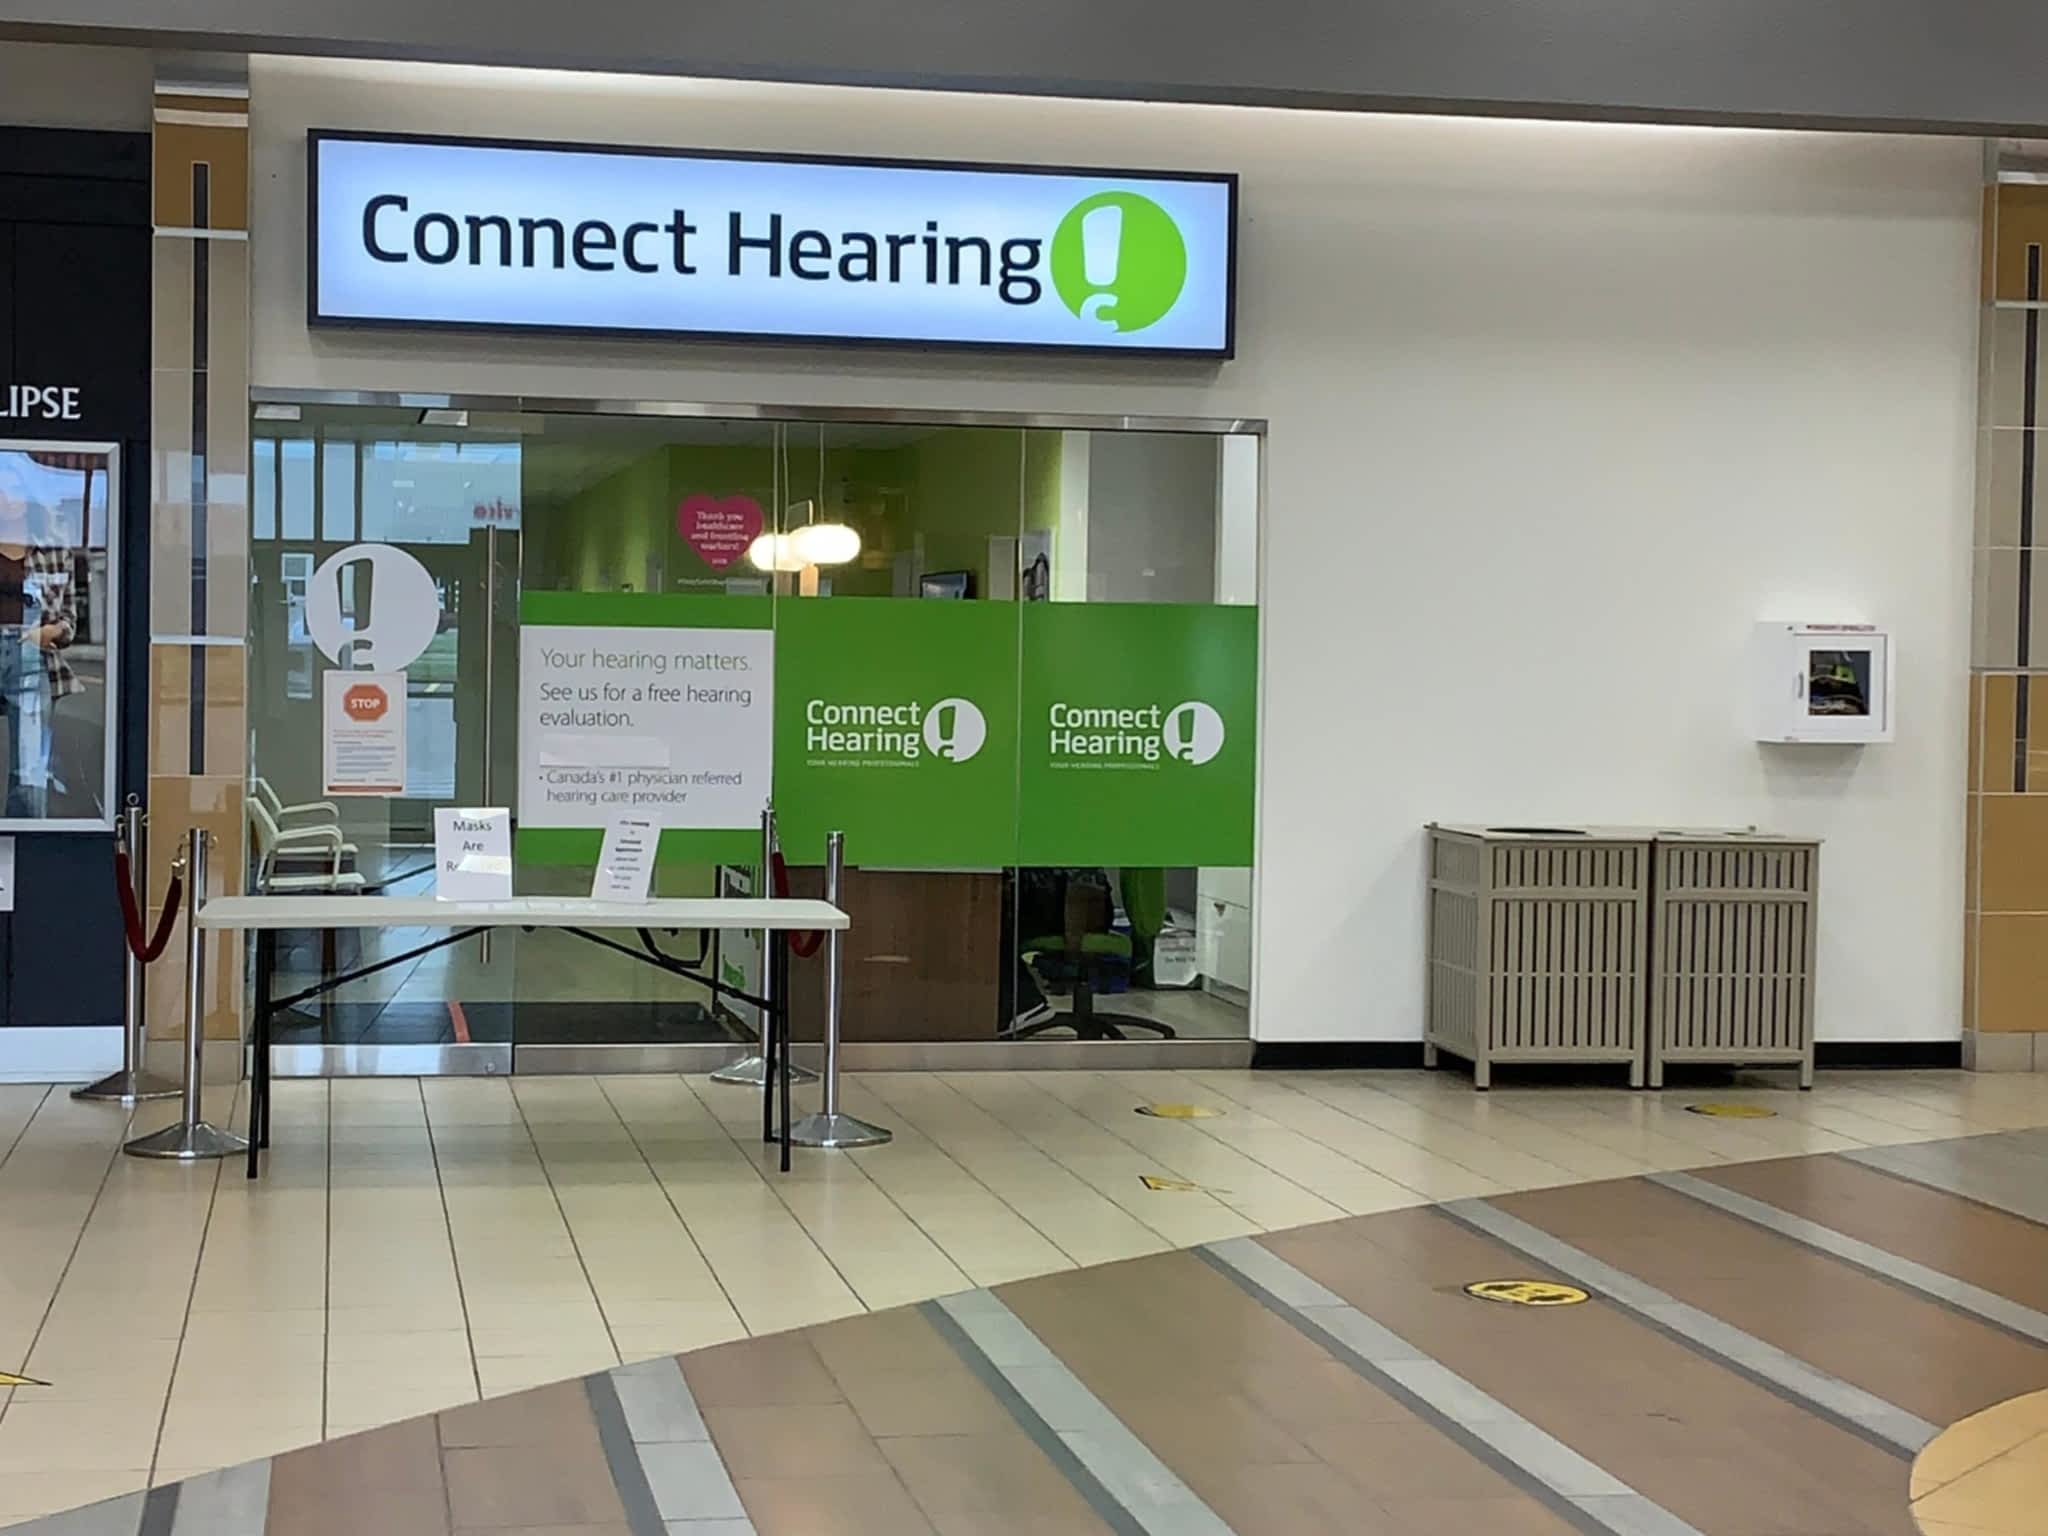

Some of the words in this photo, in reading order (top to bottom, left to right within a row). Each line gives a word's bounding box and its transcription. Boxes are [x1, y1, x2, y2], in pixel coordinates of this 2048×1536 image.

[362, 193, 698, 275] Connect
[727, 210, 1043, 306] Hearing
[540, 648, 587, 669] Your
[592, 648, 667, 675] hearing
[674, 653, 753, 672] matters.
[350, 698, 381, 709] STOP
[539, 682, 573, 702] See
[578, 686, 598, 702] us
[603, 682, 626, 702] for
[632, 687, 642, 702] a
[648, 683, 681, 703] free
[687, 684, 752, 708] hearing
[539, 708, 634, 728] evaluation.
[806, 699, 921, 726] Connect
[1050, 703, 1161, 729] Connect
[807, 726, 920, 758] Hearing
[1050, 730, 1160, 761] Hearing
[609, 771, 623, 785] #1
[627, 771, 688, 793] physician
[691, 771, 742, 786] referred
[546, 789, 597, 806] hearing
[600, 792, 629, 803] care
[632, 790, 687, 806] provider
[453, 820, 492, 832] Masks
[462, 840, 485, 852] Are
